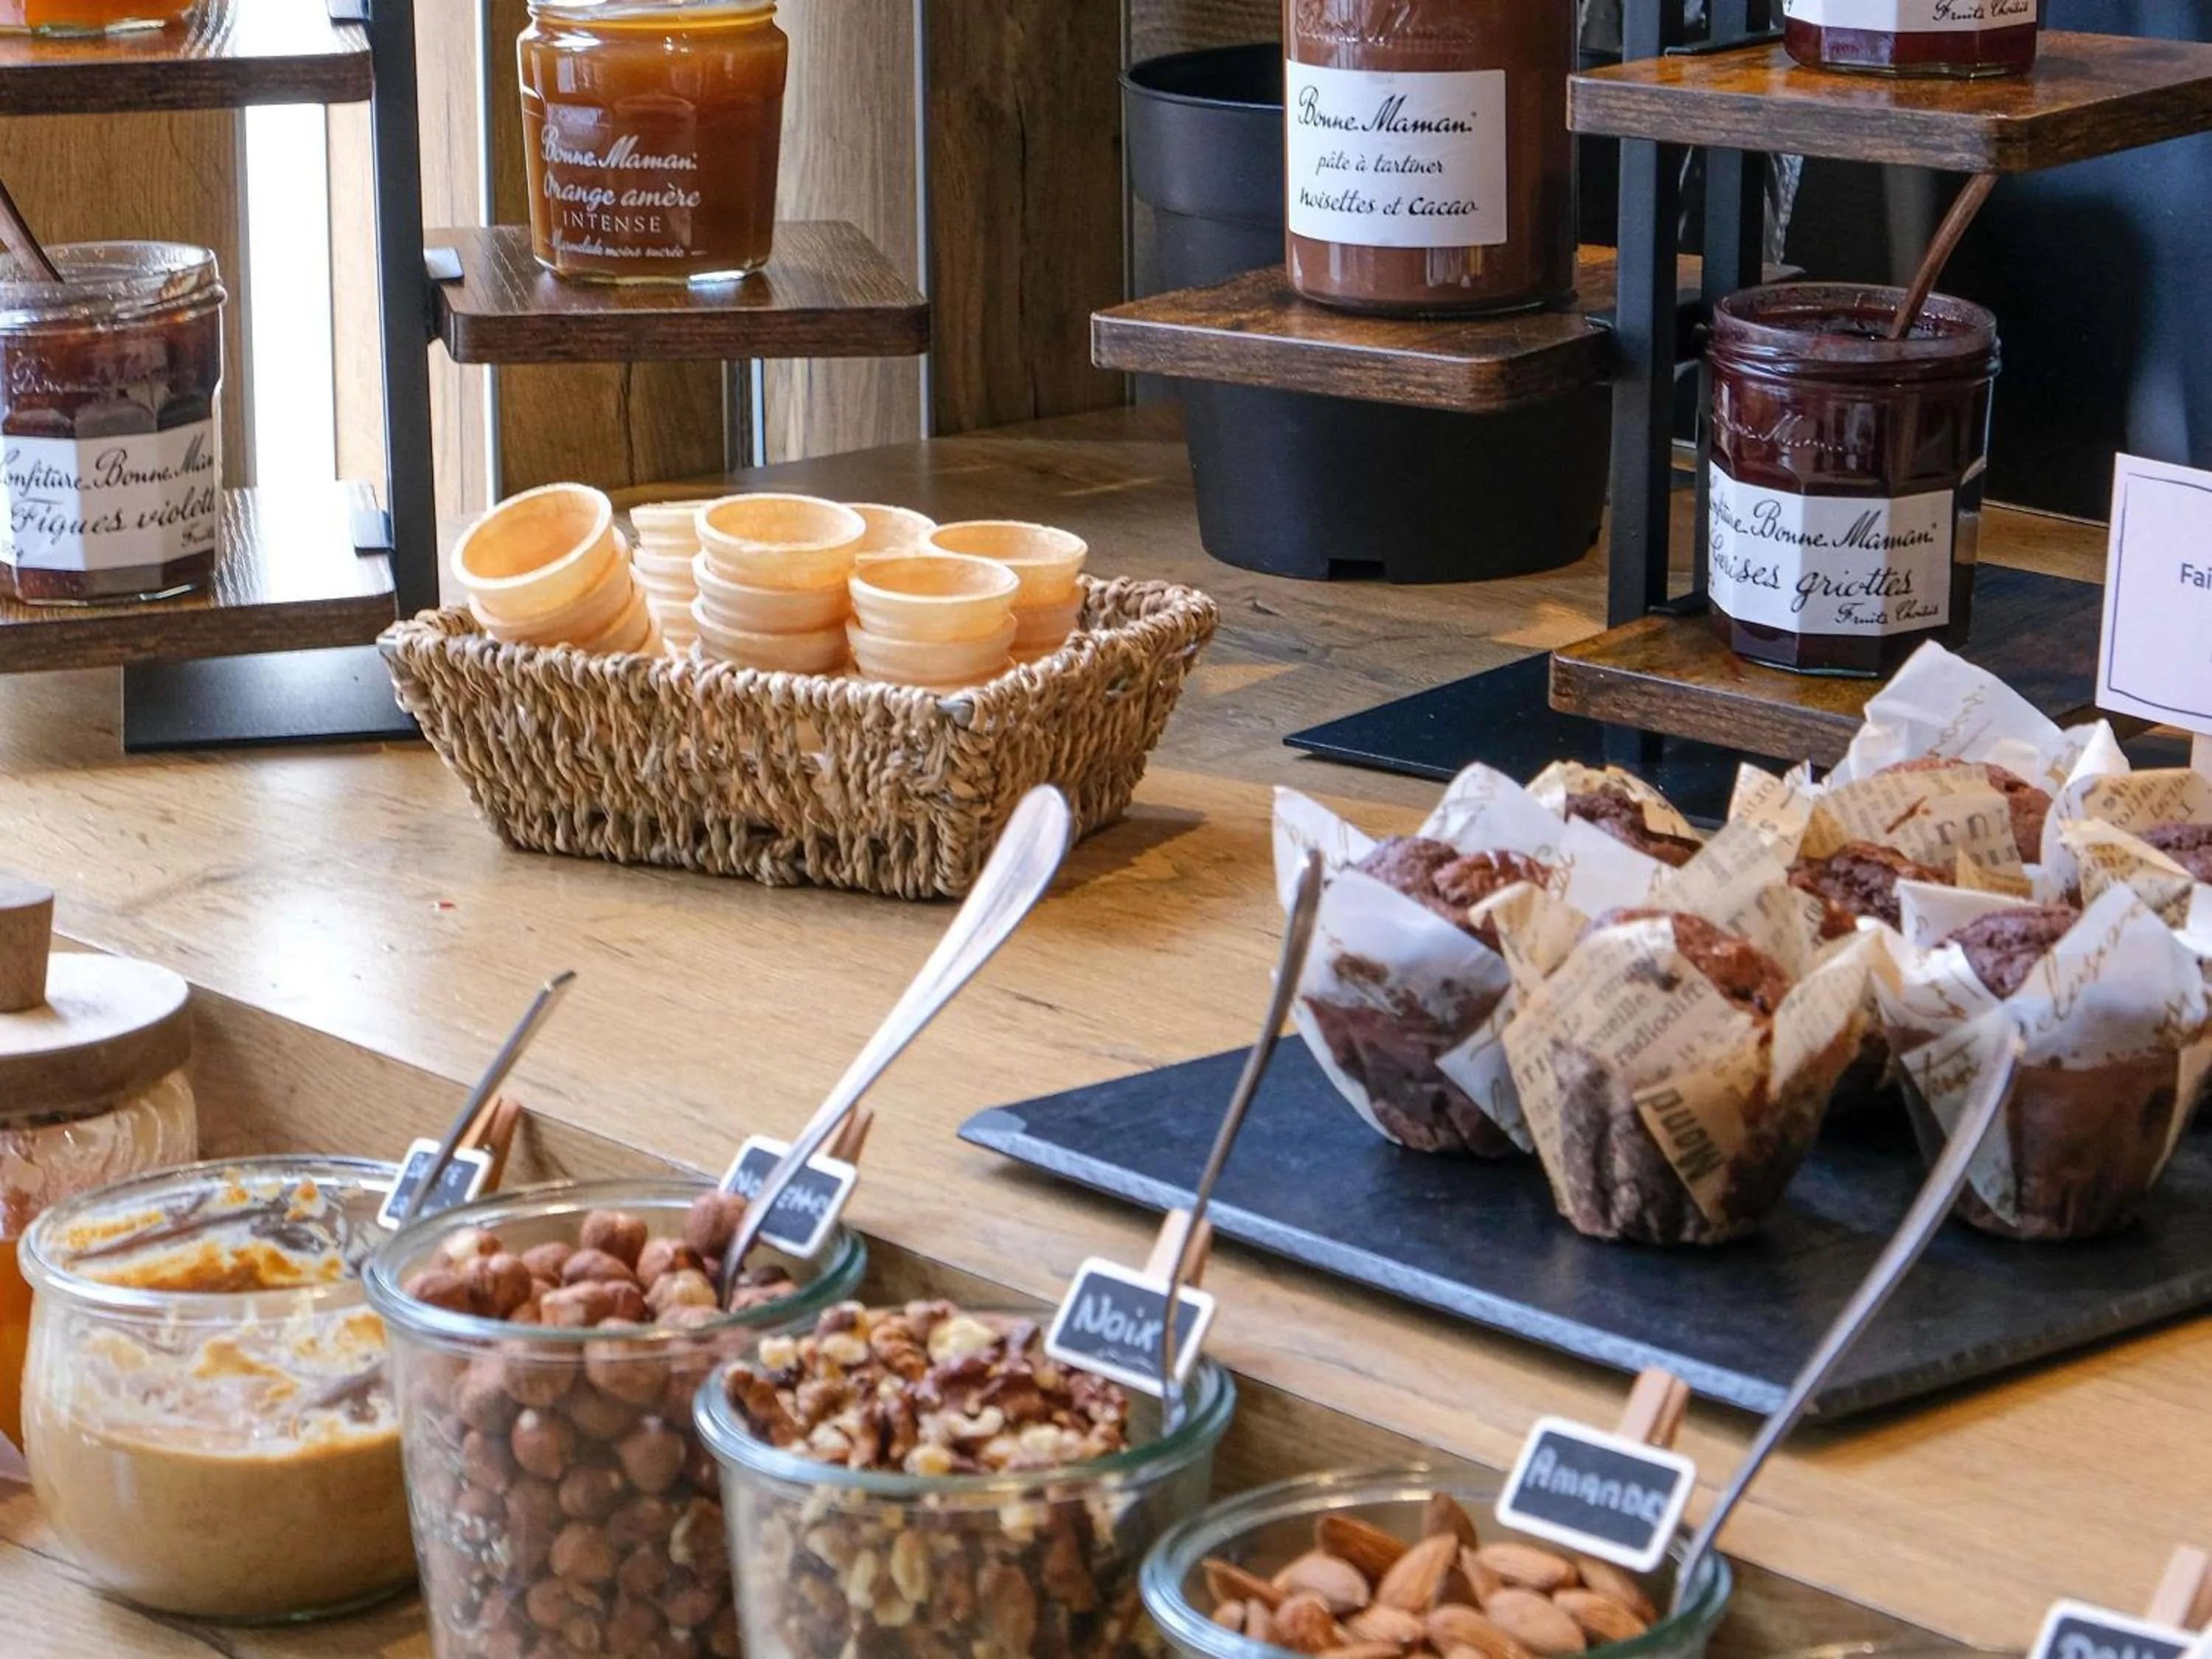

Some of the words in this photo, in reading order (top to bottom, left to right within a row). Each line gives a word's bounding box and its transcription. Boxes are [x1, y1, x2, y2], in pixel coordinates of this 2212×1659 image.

[1298, 85, 1359, 131] Bonne
[1362, 94, 1473, 133] Maman
[540, 124, 597, 167] Bonne
[598, 134, 694, 169] Maman
[1315, 150, 1350, 175] pâte
[1354, 153, 1368, 172] à
[1374, 153, 1444, 173] tartiner
[543, 170, 616, 212] Orange
[620, 183, 701, 207] amère
[1382, 196, 1402, 215] et
[563, 211, 661, 234] INTENSE
[94, 448, 173, 490] Bonne
[11, 497, 126, 545] Figues
[1750, 498, 1828, 547] Bonne
[1832, 509, 1935, 551] Maman
[1790, 567, 1915, 613] griottes
